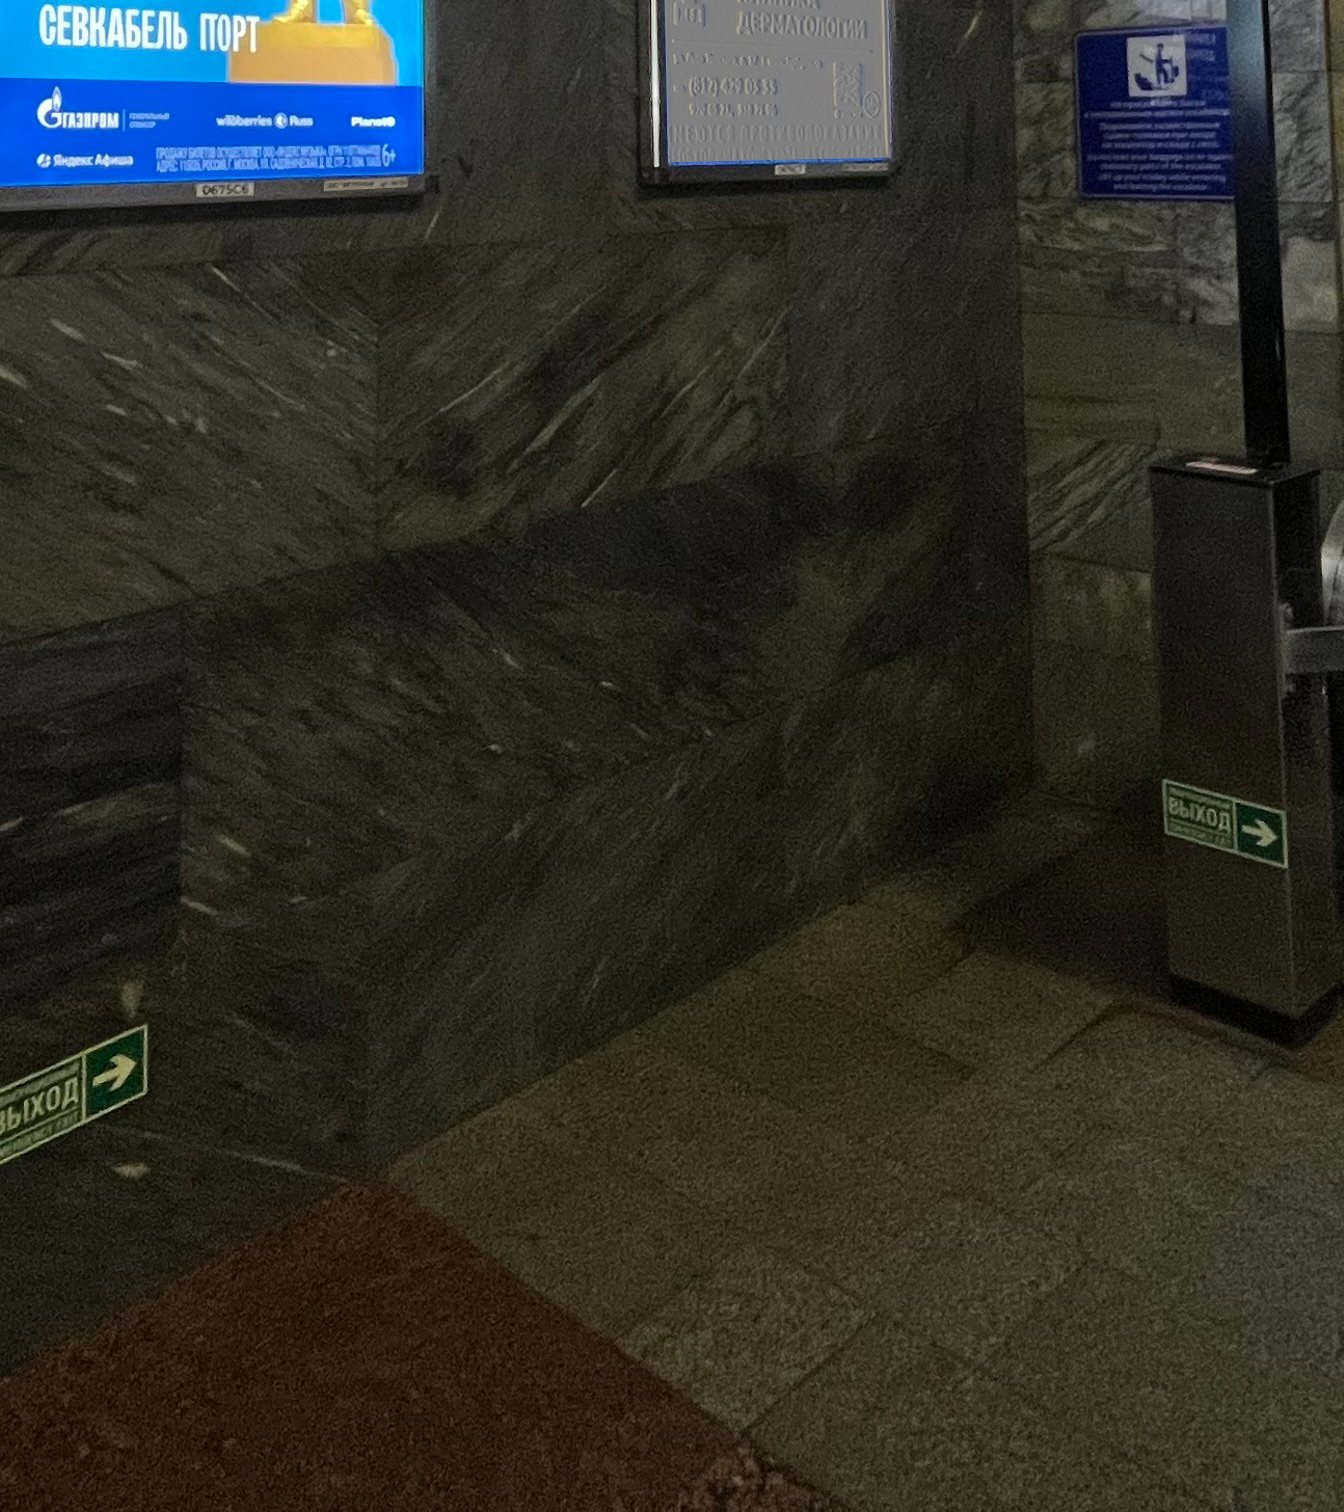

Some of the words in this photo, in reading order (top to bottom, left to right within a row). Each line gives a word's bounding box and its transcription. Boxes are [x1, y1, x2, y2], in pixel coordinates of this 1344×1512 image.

[39, 4, 188, 51] СЕВКАБЕЛЬ
[199, 14, 260, 53] ПОРТ
[62, 111, 120, 129] ГАЗПРОМ
[53, 154, 94, 168] Яндекс
[94, 153, 134, 168] Афиша
[382, 144, 397, 167] 6+
[1168, 796, 1231, 835] ВЫХОД
